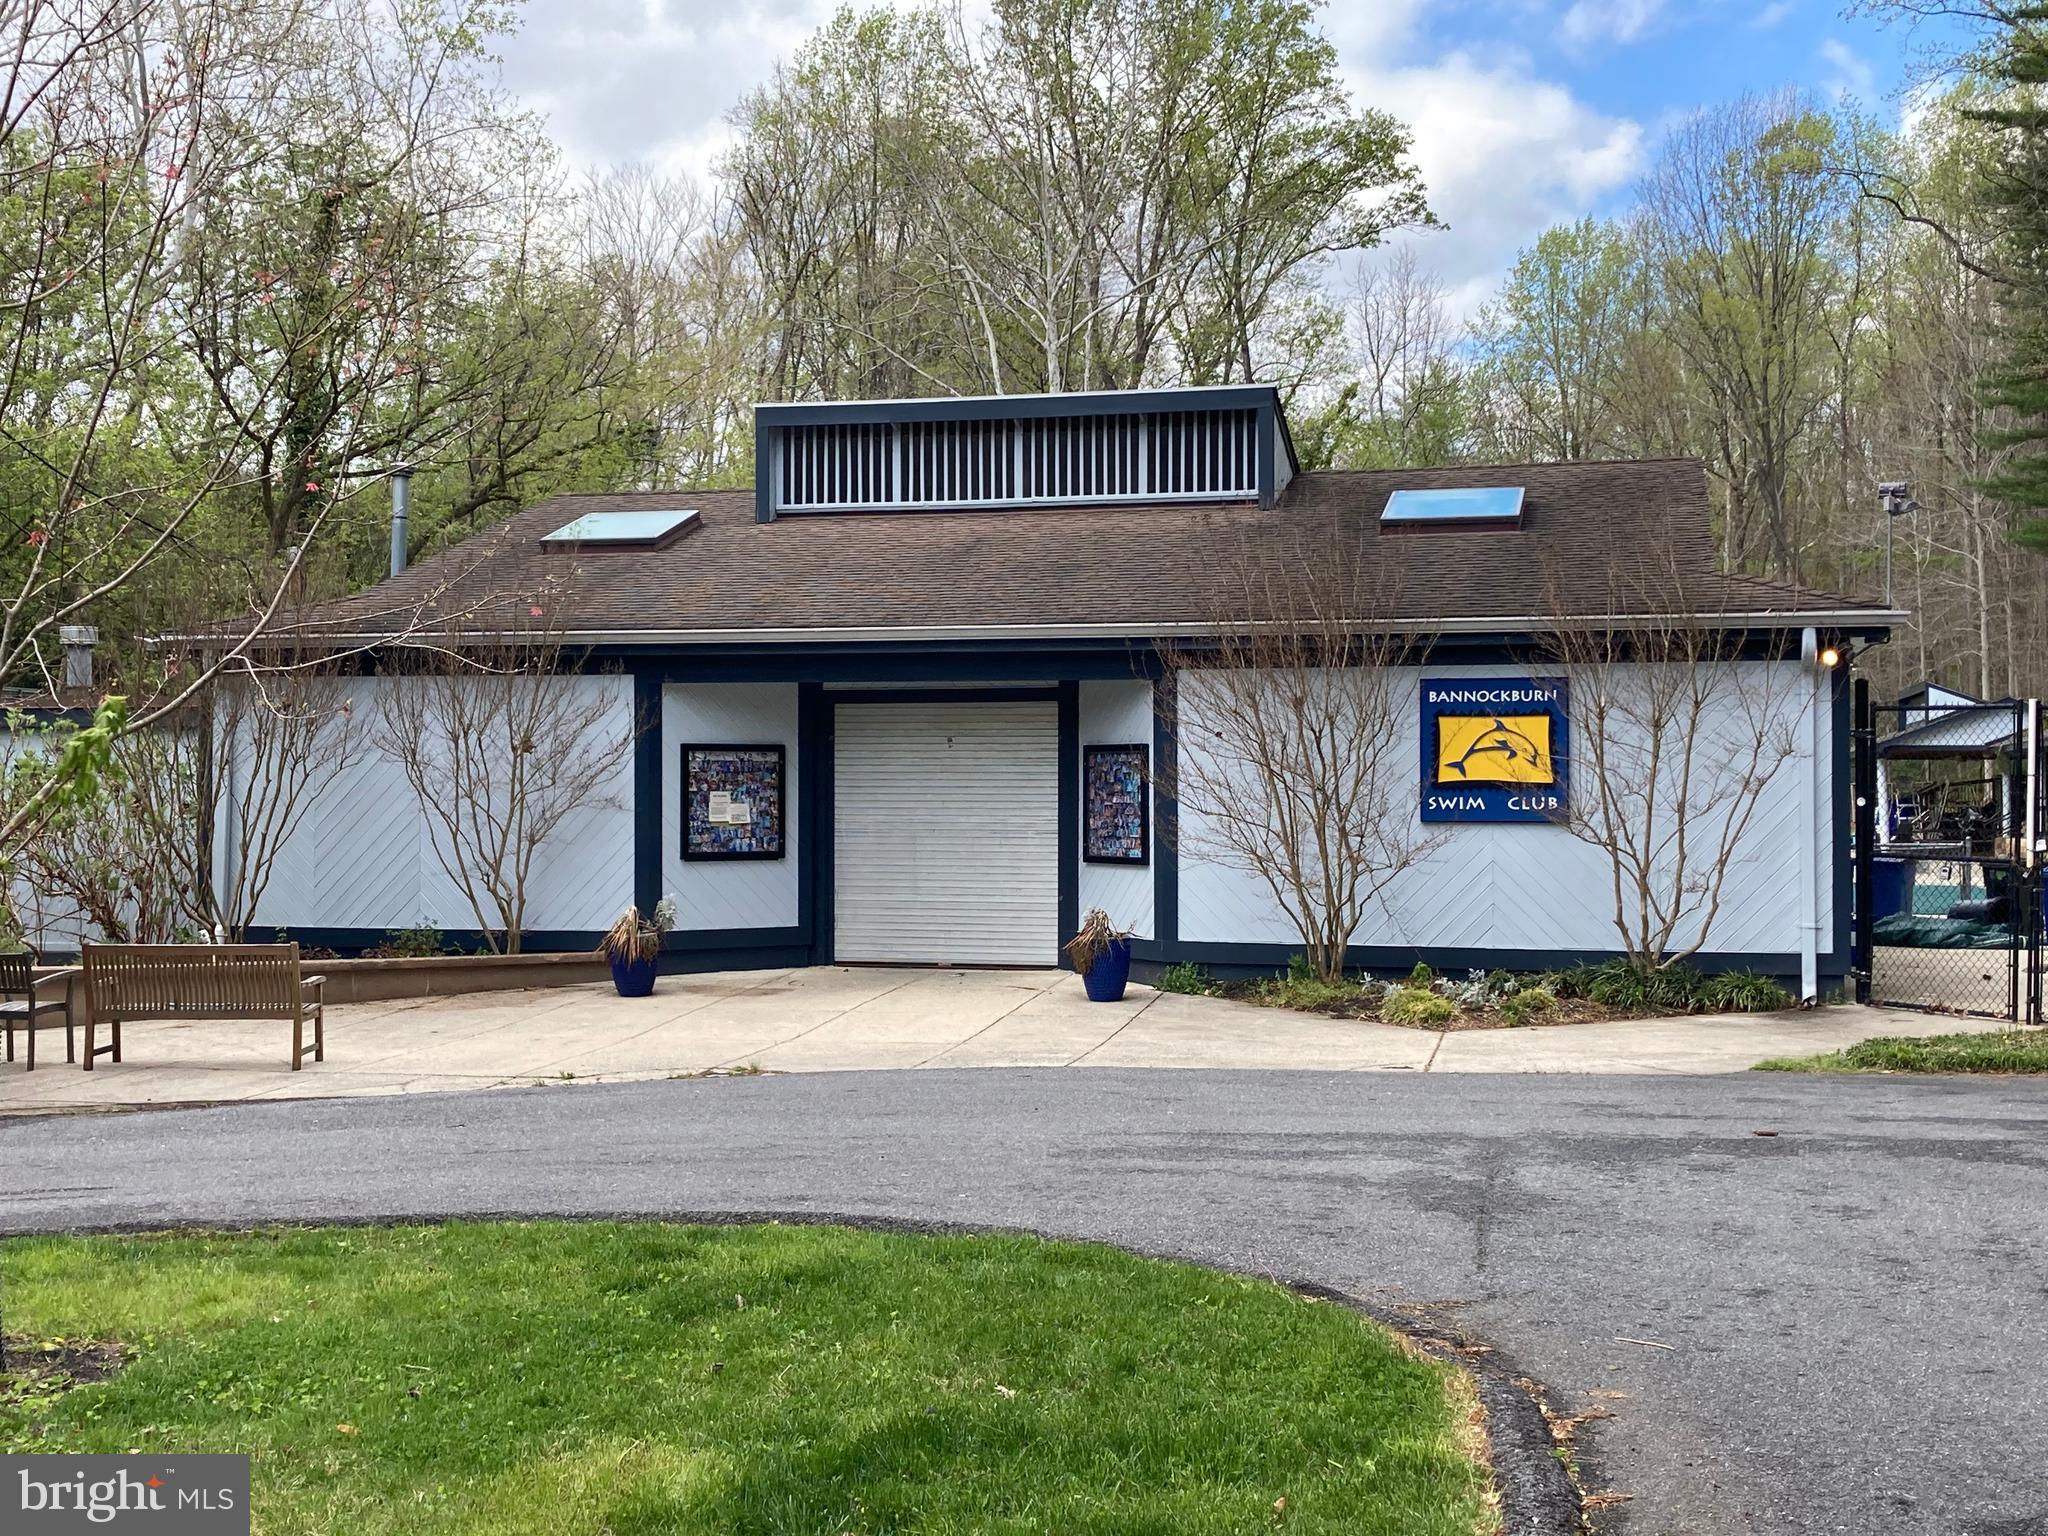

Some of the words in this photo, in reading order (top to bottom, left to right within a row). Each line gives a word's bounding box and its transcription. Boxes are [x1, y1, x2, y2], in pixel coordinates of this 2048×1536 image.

[1429, 690, 1557, 703] BANNOCKBURN
[1428, 797, 1486, 810] SWIM
[1507, 797, 1558, 810] CLUB
